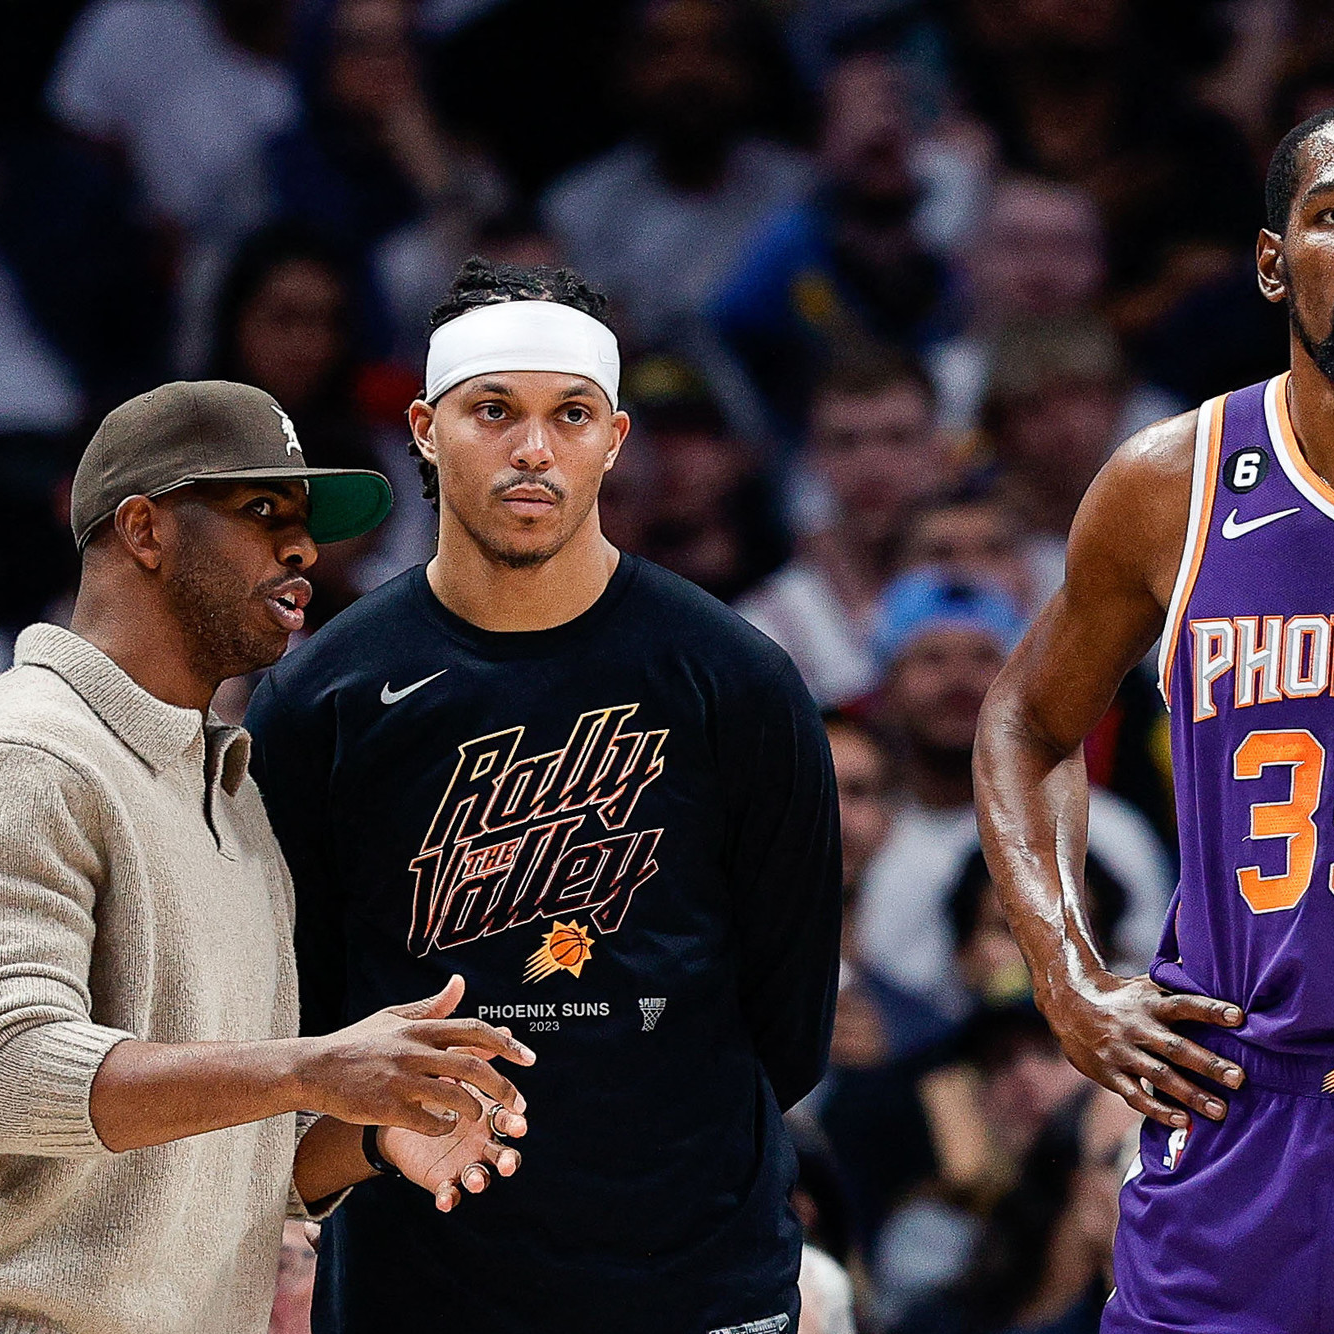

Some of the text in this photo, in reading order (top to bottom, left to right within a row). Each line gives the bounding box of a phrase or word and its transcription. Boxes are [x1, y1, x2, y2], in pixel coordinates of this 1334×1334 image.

[1233, 452, 1262, 488] 6
[419, 702, 670, 855] Rally
[463, 837, 522, 879] THE
[407, 814, 665, 958] Valley
[477, 1002, 611, 1019] PHOENIX SUNS
[529, 1021, 560, 1032] 2023
